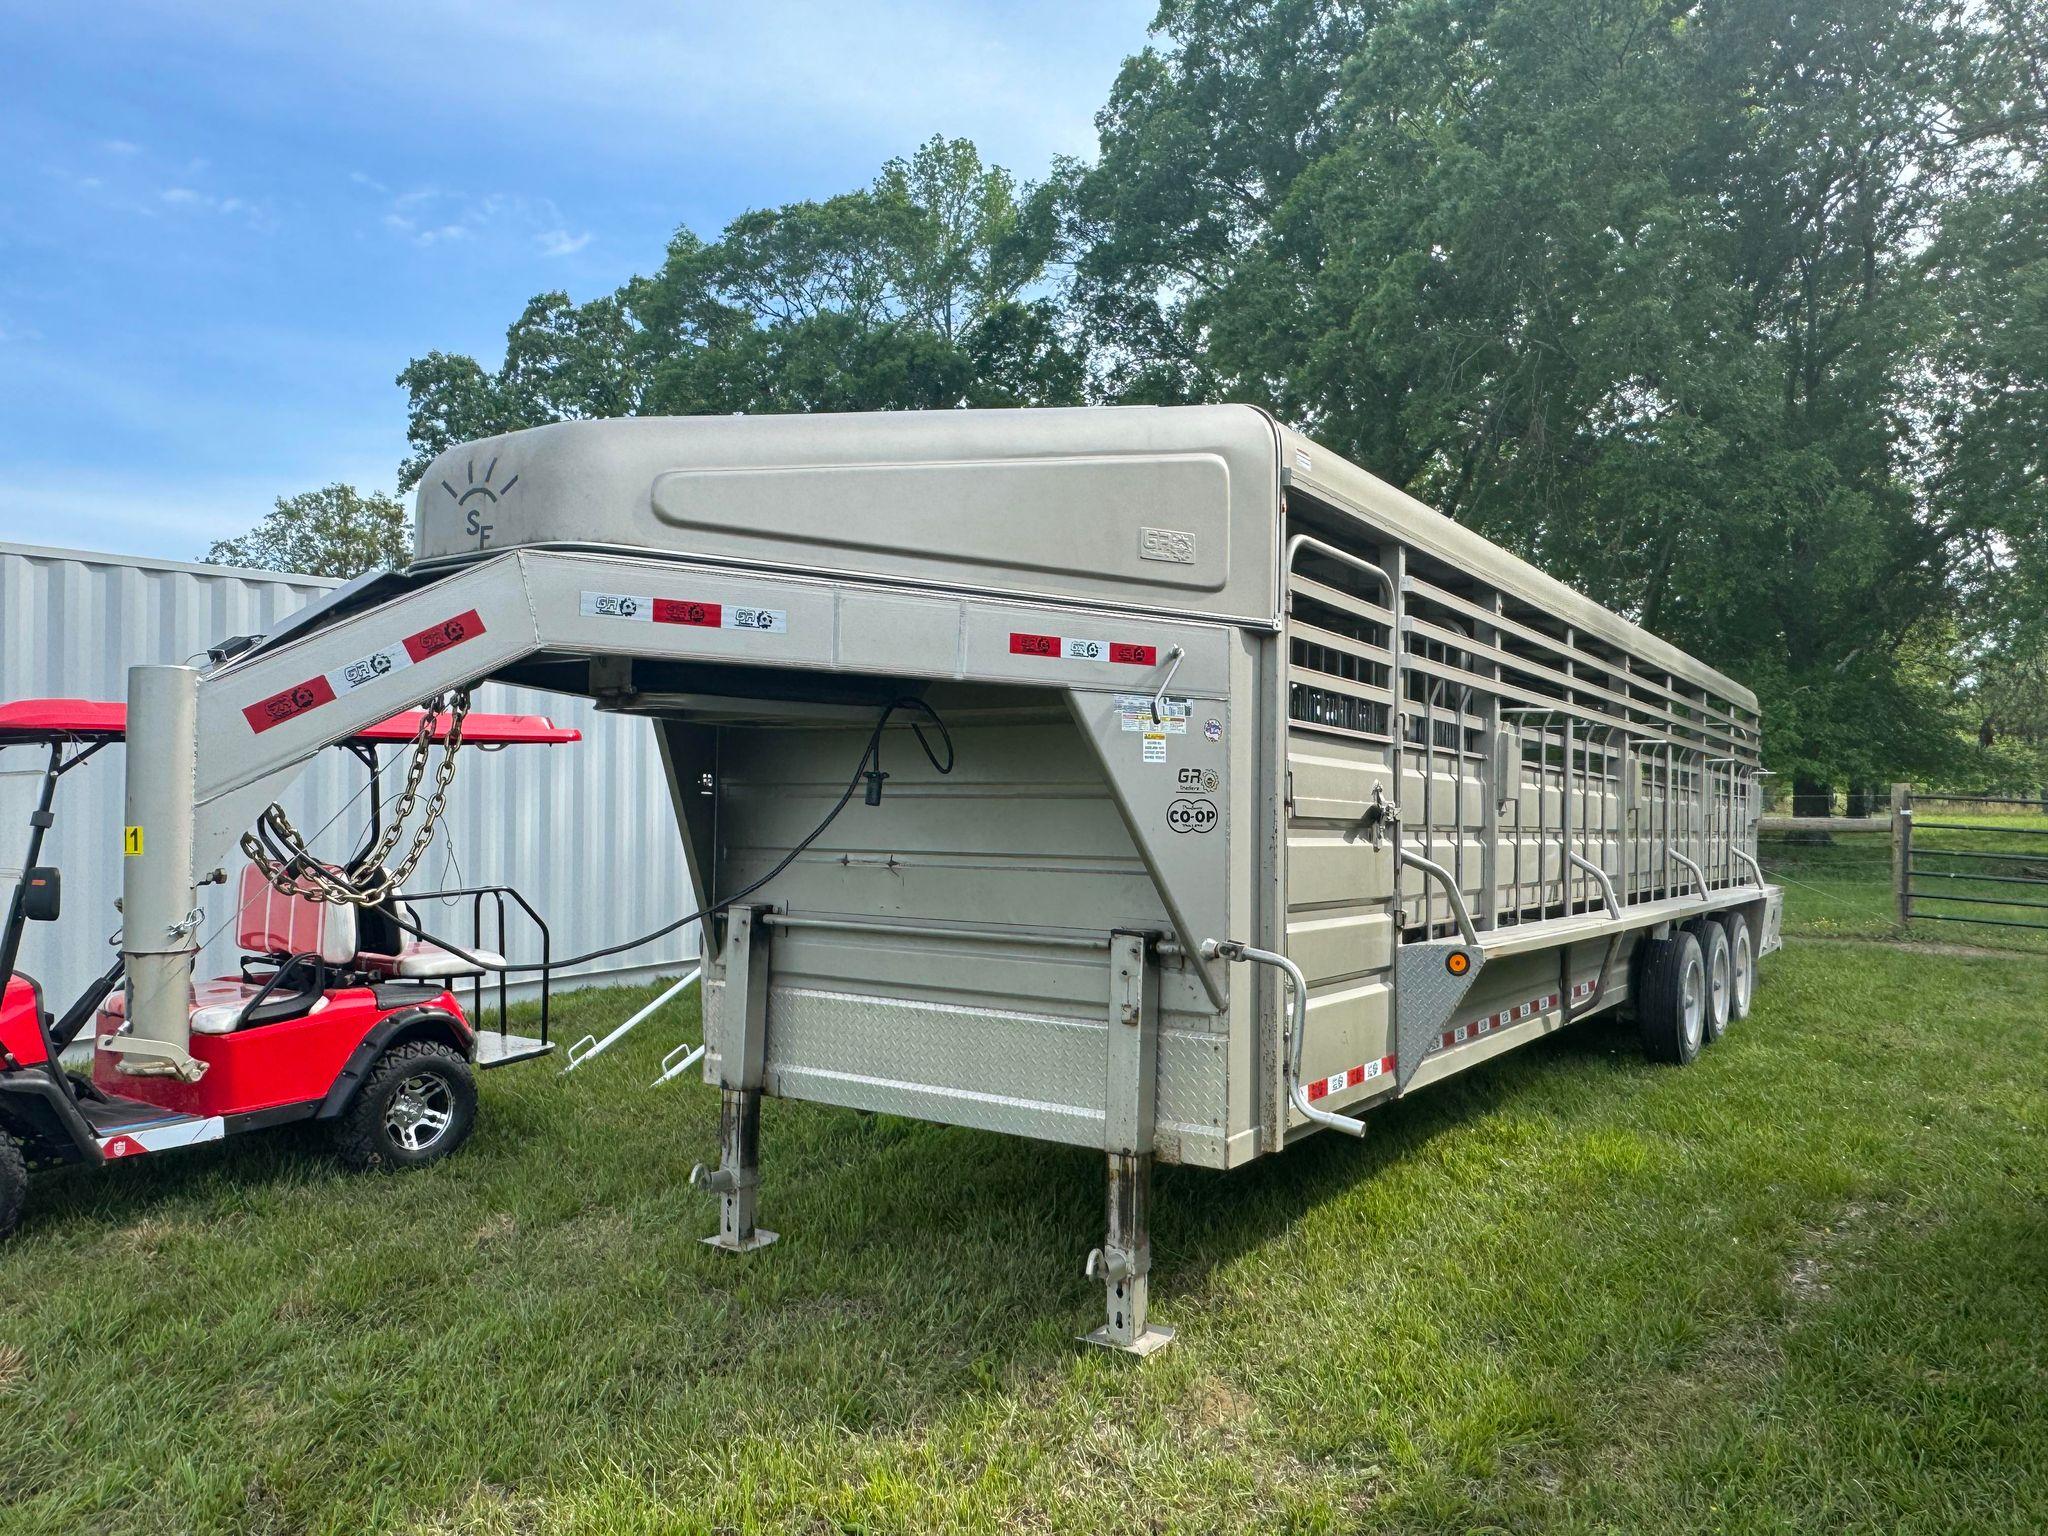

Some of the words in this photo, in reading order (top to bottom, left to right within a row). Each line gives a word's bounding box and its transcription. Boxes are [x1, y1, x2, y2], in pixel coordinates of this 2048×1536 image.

[466, 509, 480, 536] S
[480, 525, 494, 550] F
[596, 596, 618, 610] GR
[735, 608, 756, 622] GR
[344, 660, 370, 682] GR
[1178, 768, 1202, 783] GR
[1169, 810, 1216, 823] CO-OP
